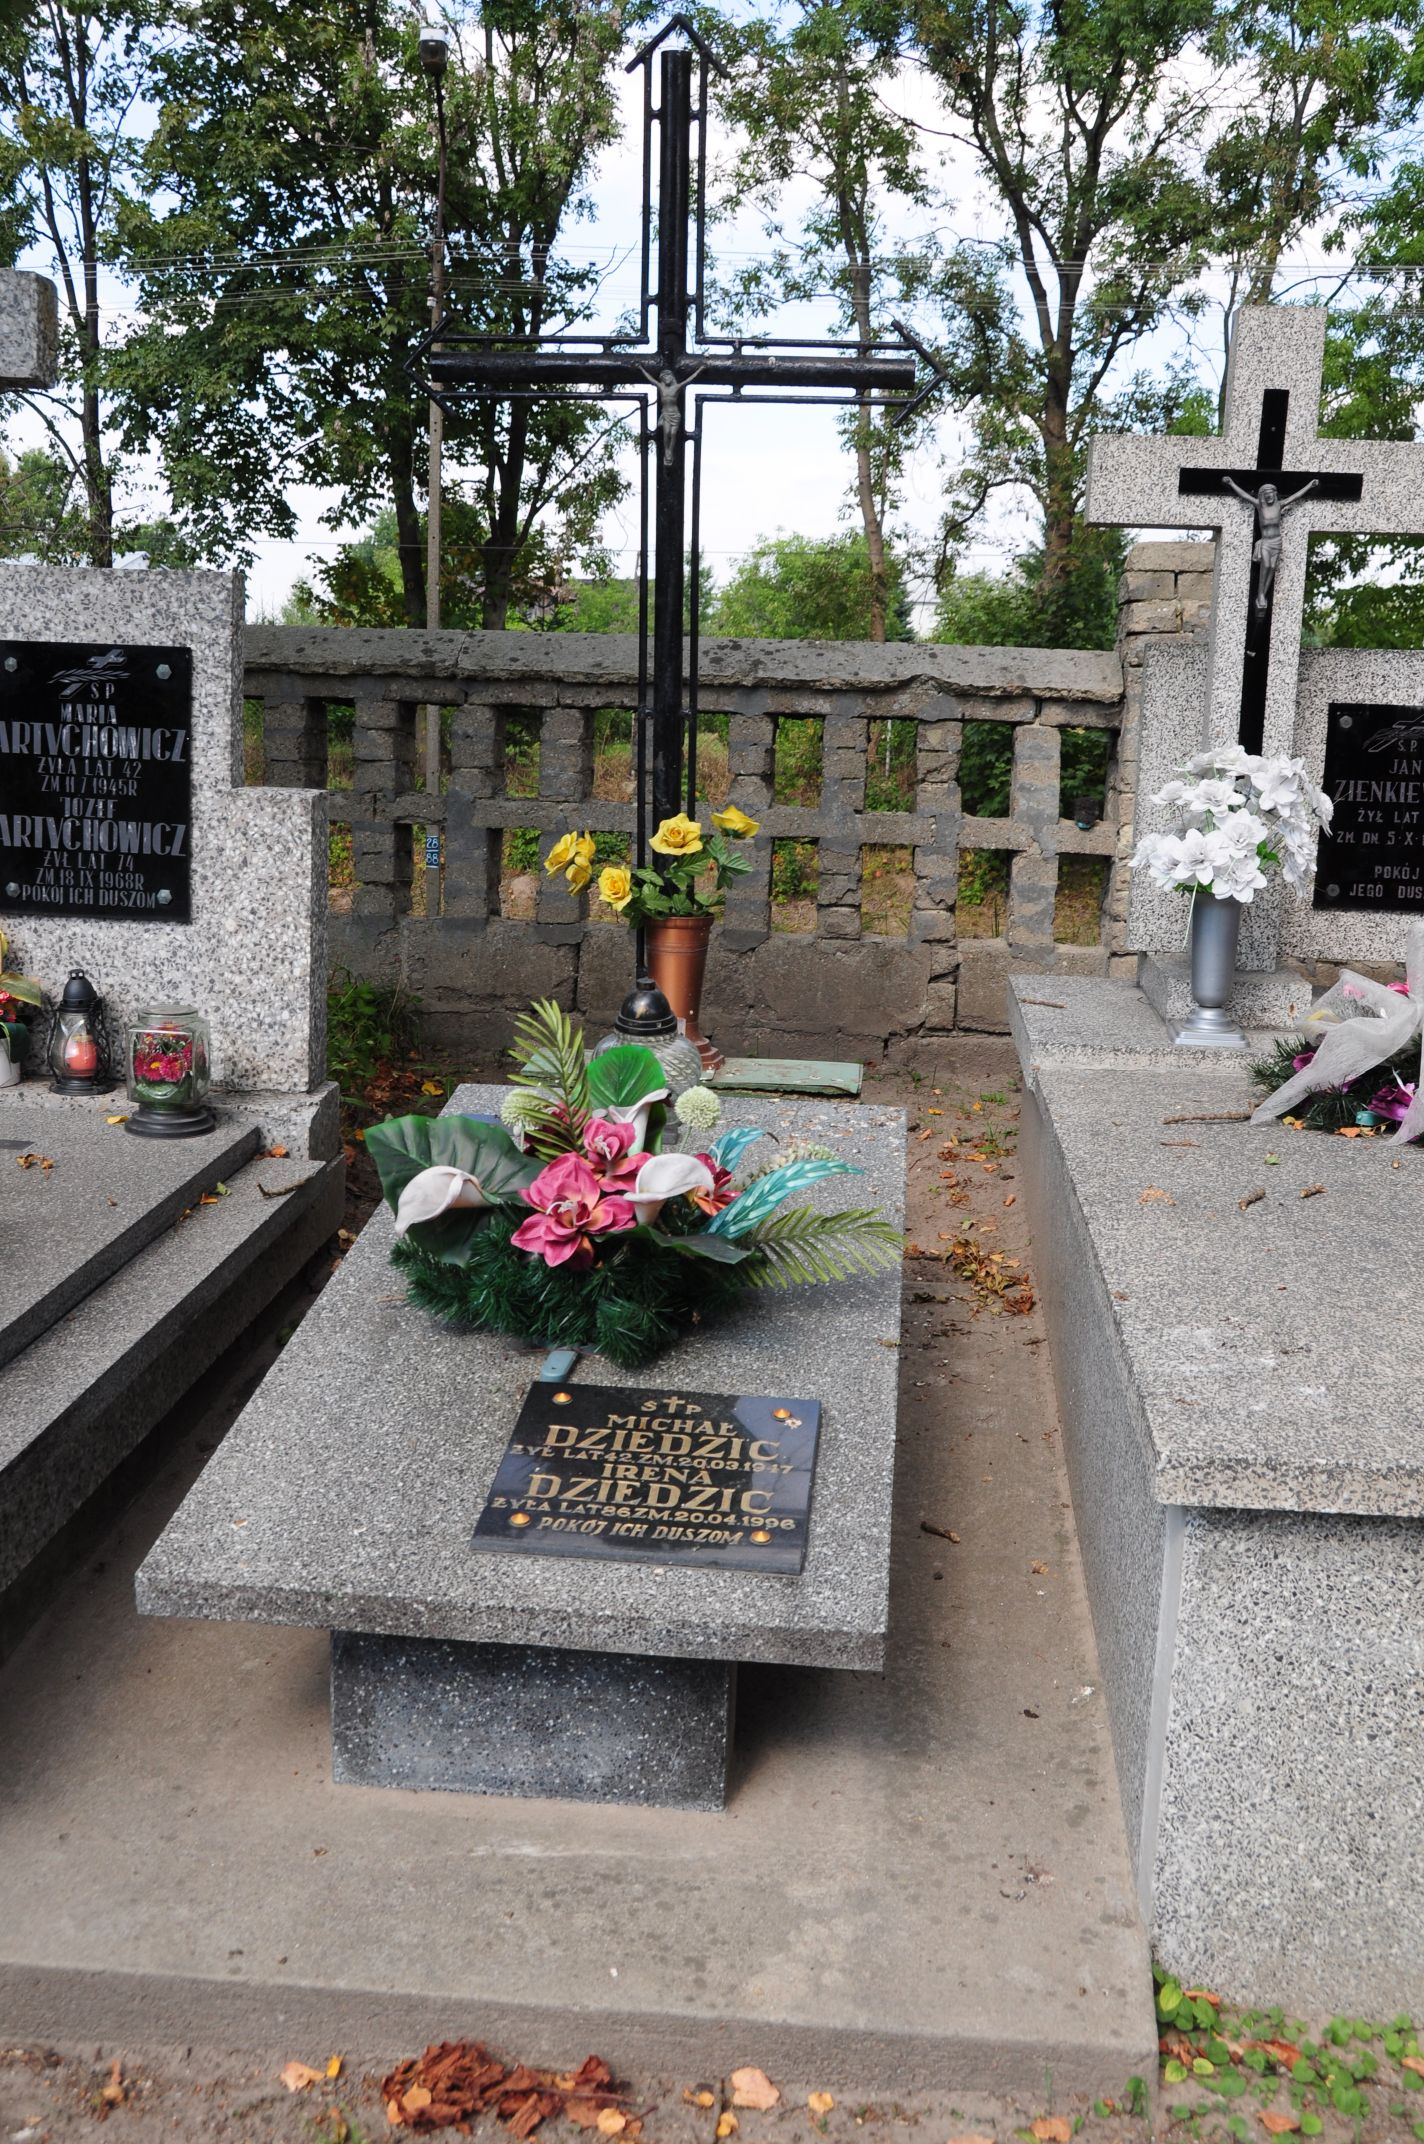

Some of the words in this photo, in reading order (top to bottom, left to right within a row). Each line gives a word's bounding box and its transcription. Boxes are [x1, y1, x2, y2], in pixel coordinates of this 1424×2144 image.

[60, 703, 118, 725] MARIA
[85, 759, 115, 777] LAT
[122, 761, 142, 779] 42
[1388, 759, 1422, 775] JAN
[41, 775, 60, 792] ZM
[1333, 779, 1424, 804] ZIENKIE
[1393, 811, 1420, 824] LAT
[426, 838, 439, 849] 28
[78, 852, 107, 870] LAT
[118, 854, 135, 872] 74
[1374, 862, 1420, 880] POKÓJ
[36, 867, 55, 886] ZM
[60, 869, 74, 887] 18
[80, 870, 95, 888] IX
[100, 871, 144, 891] 1968R
[22, 884, 64, 905] POKÓJ
[69, 887, 94, 906] ICH
[99, 889, 156, 909] DUSZOM
[1397, 885, 1424, 899] DUS
[607, 1414, 738, 1437] MICHAŁ
[544, 1424, 781, 1462] DZIEDZIC
[601, 1463, 713, 1485] IRENA
[524, 1474, 776, 1515] DZIEDZIC
[536, 1516, 608, 1536] POKÓJ
[609, 1522, 649, 1538] ICH
[651, 1526, 744, 1545] DUSZOM
